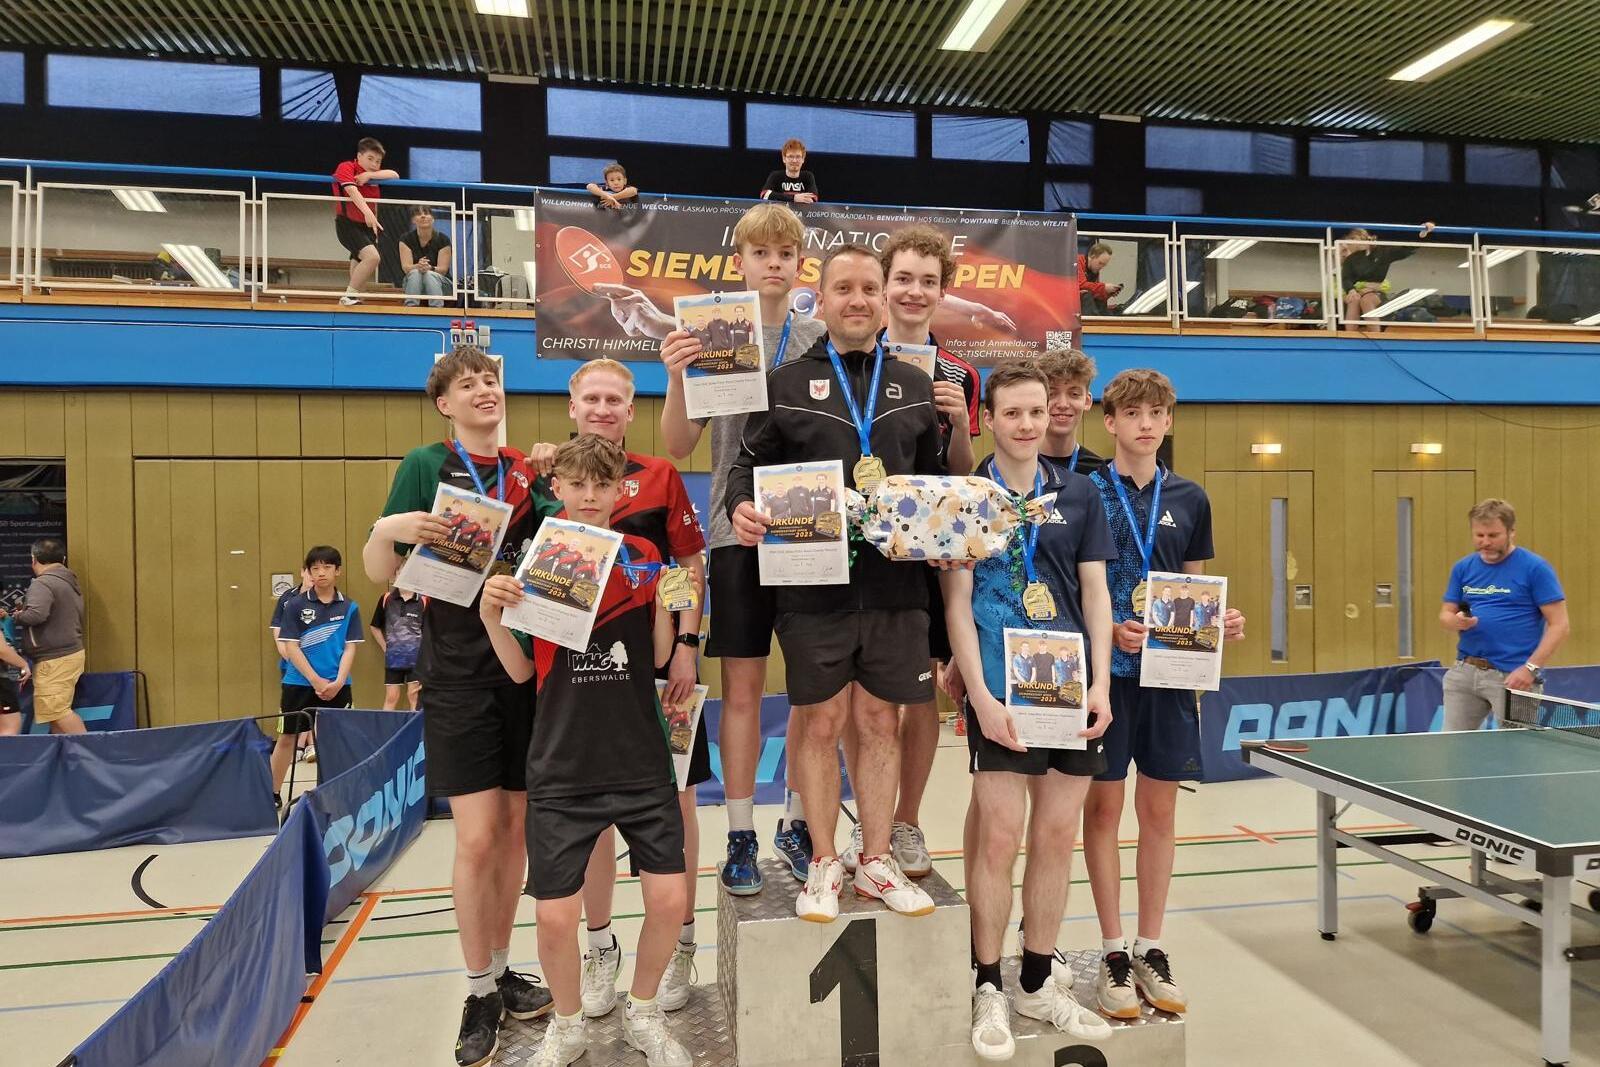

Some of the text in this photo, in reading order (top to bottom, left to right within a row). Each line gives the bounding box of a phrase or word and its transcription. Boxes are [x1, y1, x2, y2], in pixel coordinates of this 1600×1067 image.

[781, 182, 805, 191] NASA
[540, 198, 594, 208] WILLKOMMEN
[641, 203, 679, 212] WELCOME
[953, 264, 1025, 289] PEN
[542, 337, 600, 350] CHRISTI
[945, 338, 1040, 349] Infos und Anmeldung:
[697, 349, 734, 359] RKUNDE
[769, 516, 814, 527] URKUNDE
[528, 567, 573, 587] URKUNDE
[547, 588, 567, 599] 2025
[571, 673, 631, 684] EBERSWALDE
[1455, 827, 1525, 861] DONIC
[808, 918, 880, 1067] 1
